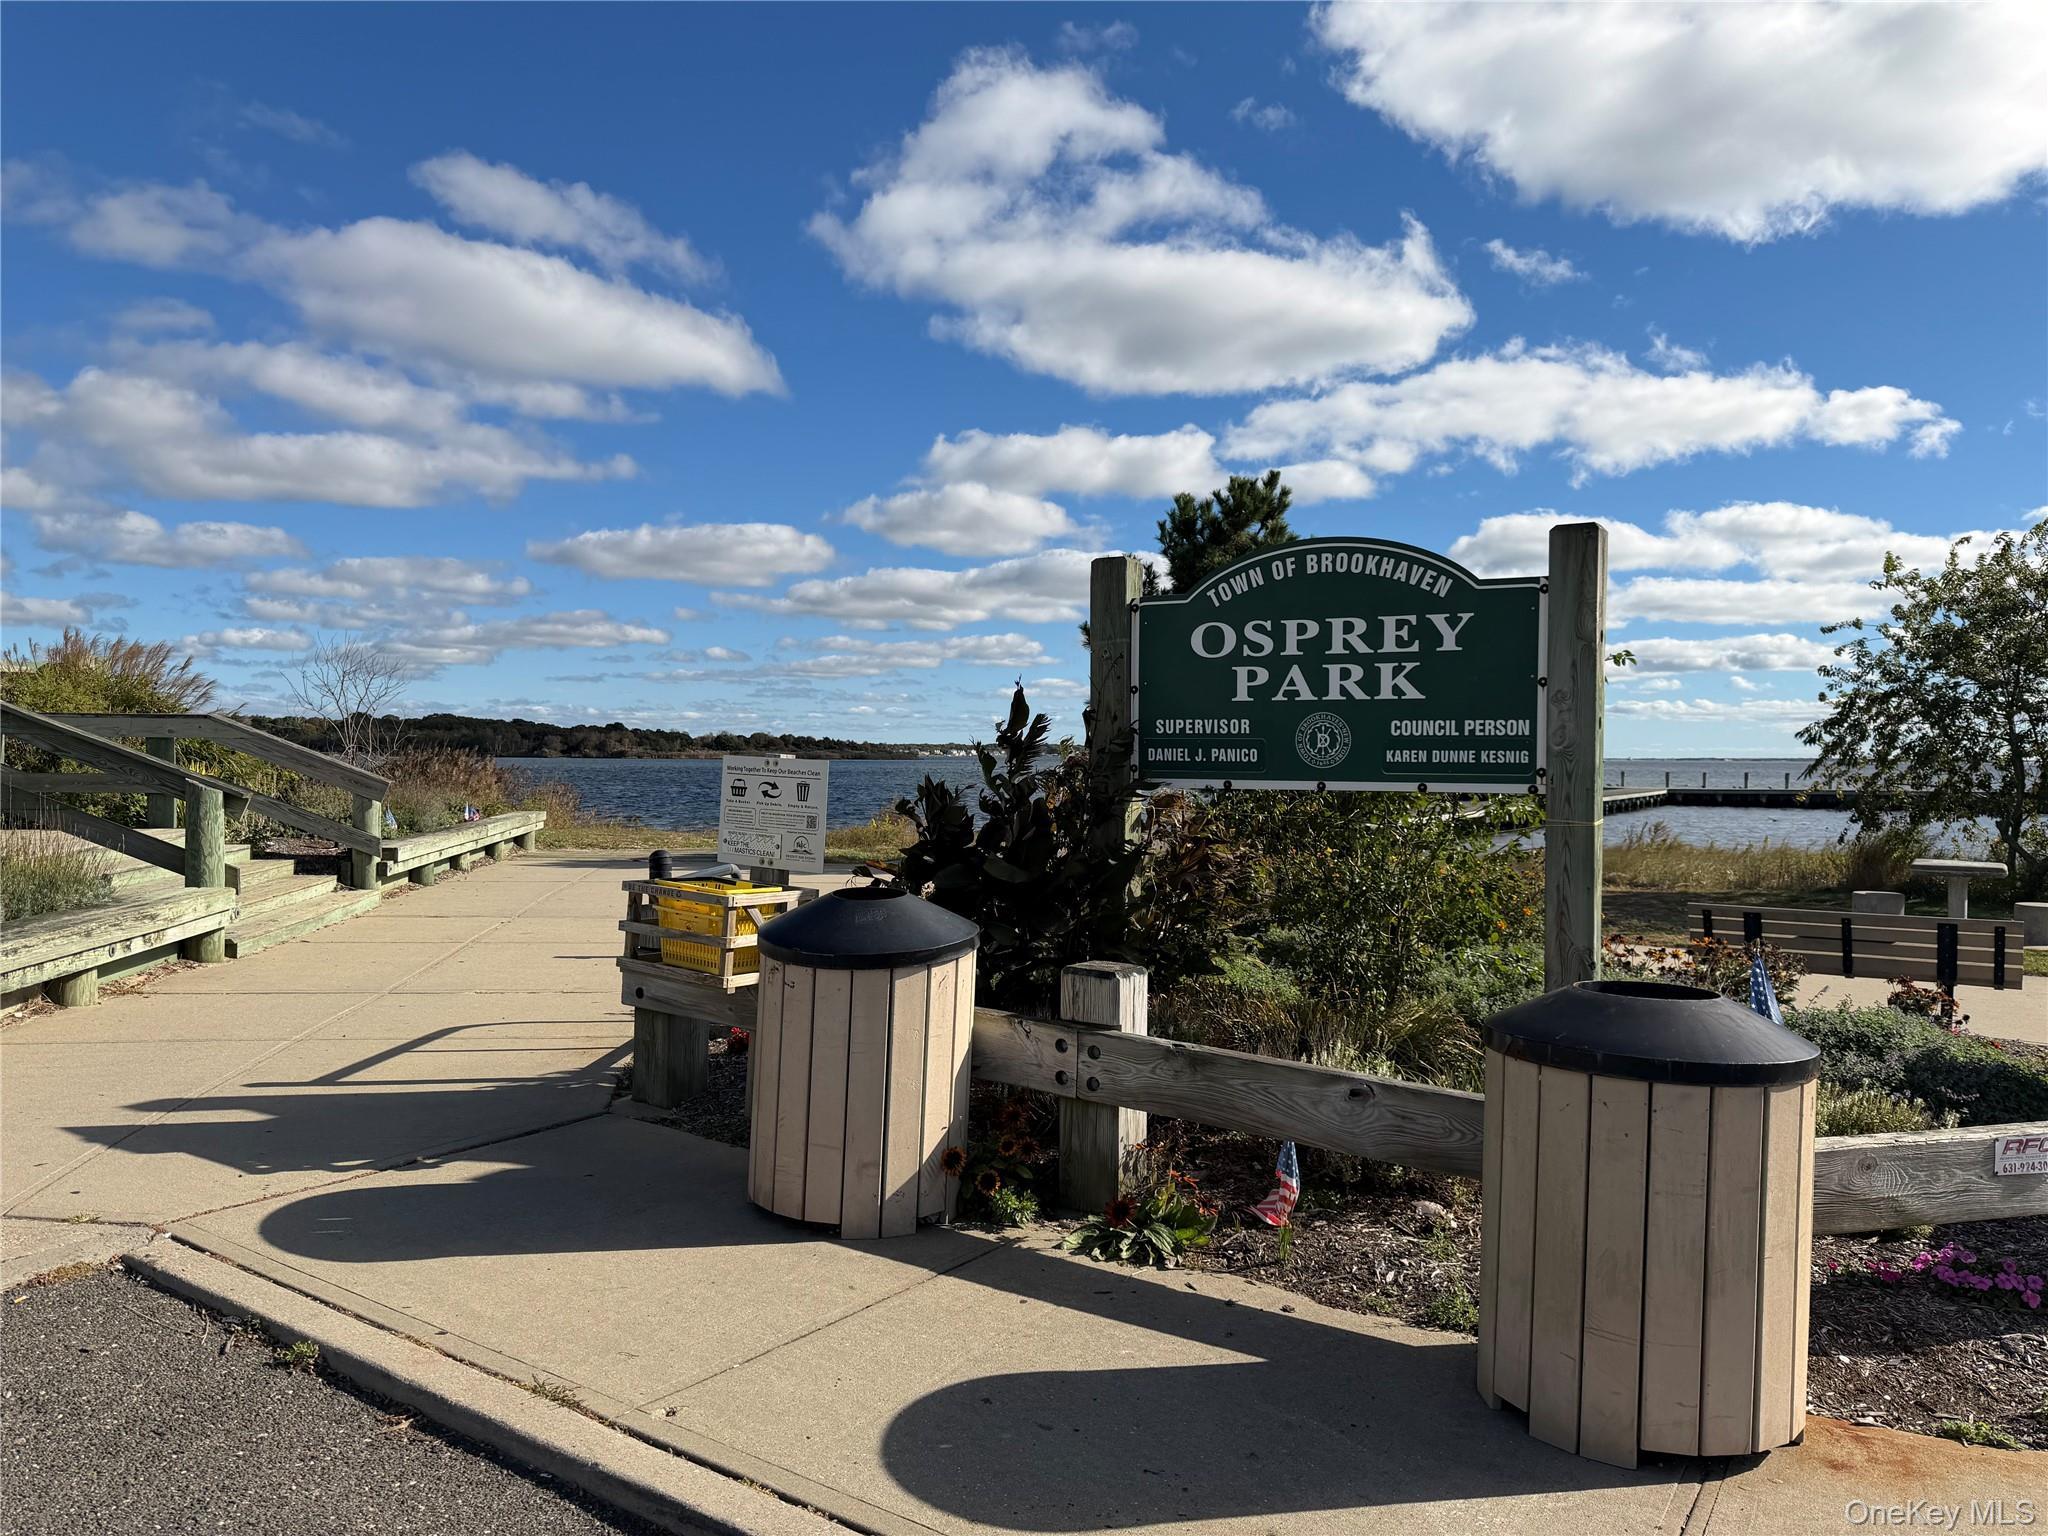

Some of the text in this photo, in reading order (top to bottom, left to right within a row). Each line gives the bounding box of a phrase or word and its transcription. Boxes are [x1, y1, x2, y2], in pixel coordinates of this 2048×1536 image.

[1206, 552, 1453, 608] TOWN OF BROOKHAVEN
[1190, 612, 1475, 658] OSPREY
[1231, 662, 1426, 701] PARK
[1155, 718, 1250, 734] SUPERVISOR
[1390, 719, 1530, 736] COUNCIL PERSON
[1148, 748, 1258, 762] DANIEL J. PANICO
[1386, 750, 1529, 764] KAREN DUNNE KESNIG
[726, 765, 743, 773] Working
[734, 847, 756, 855] MASTICS
